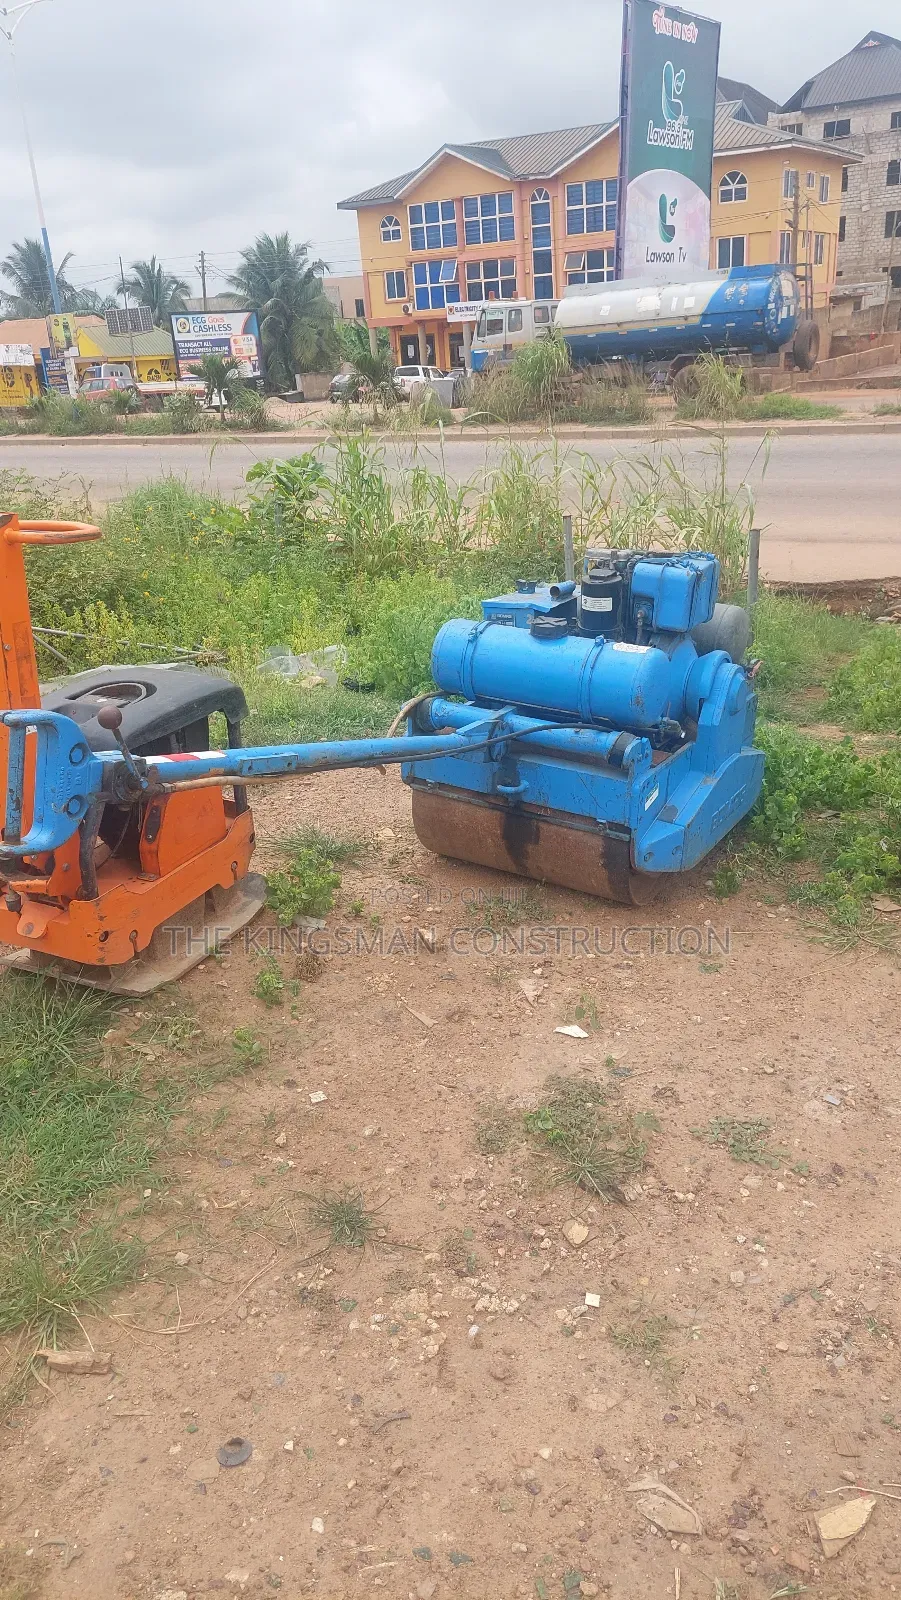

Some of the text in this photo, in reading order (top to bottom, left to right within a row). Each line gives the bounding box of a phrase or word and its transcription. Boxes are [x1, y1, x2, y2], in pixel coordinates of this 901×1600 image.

[673, 21, 681, 39] IN
[647, 120, 695, 150] Lawson FM
[645, 246, 675, 263] Lawson
[192, 324, 232, 333] CASHLESS
